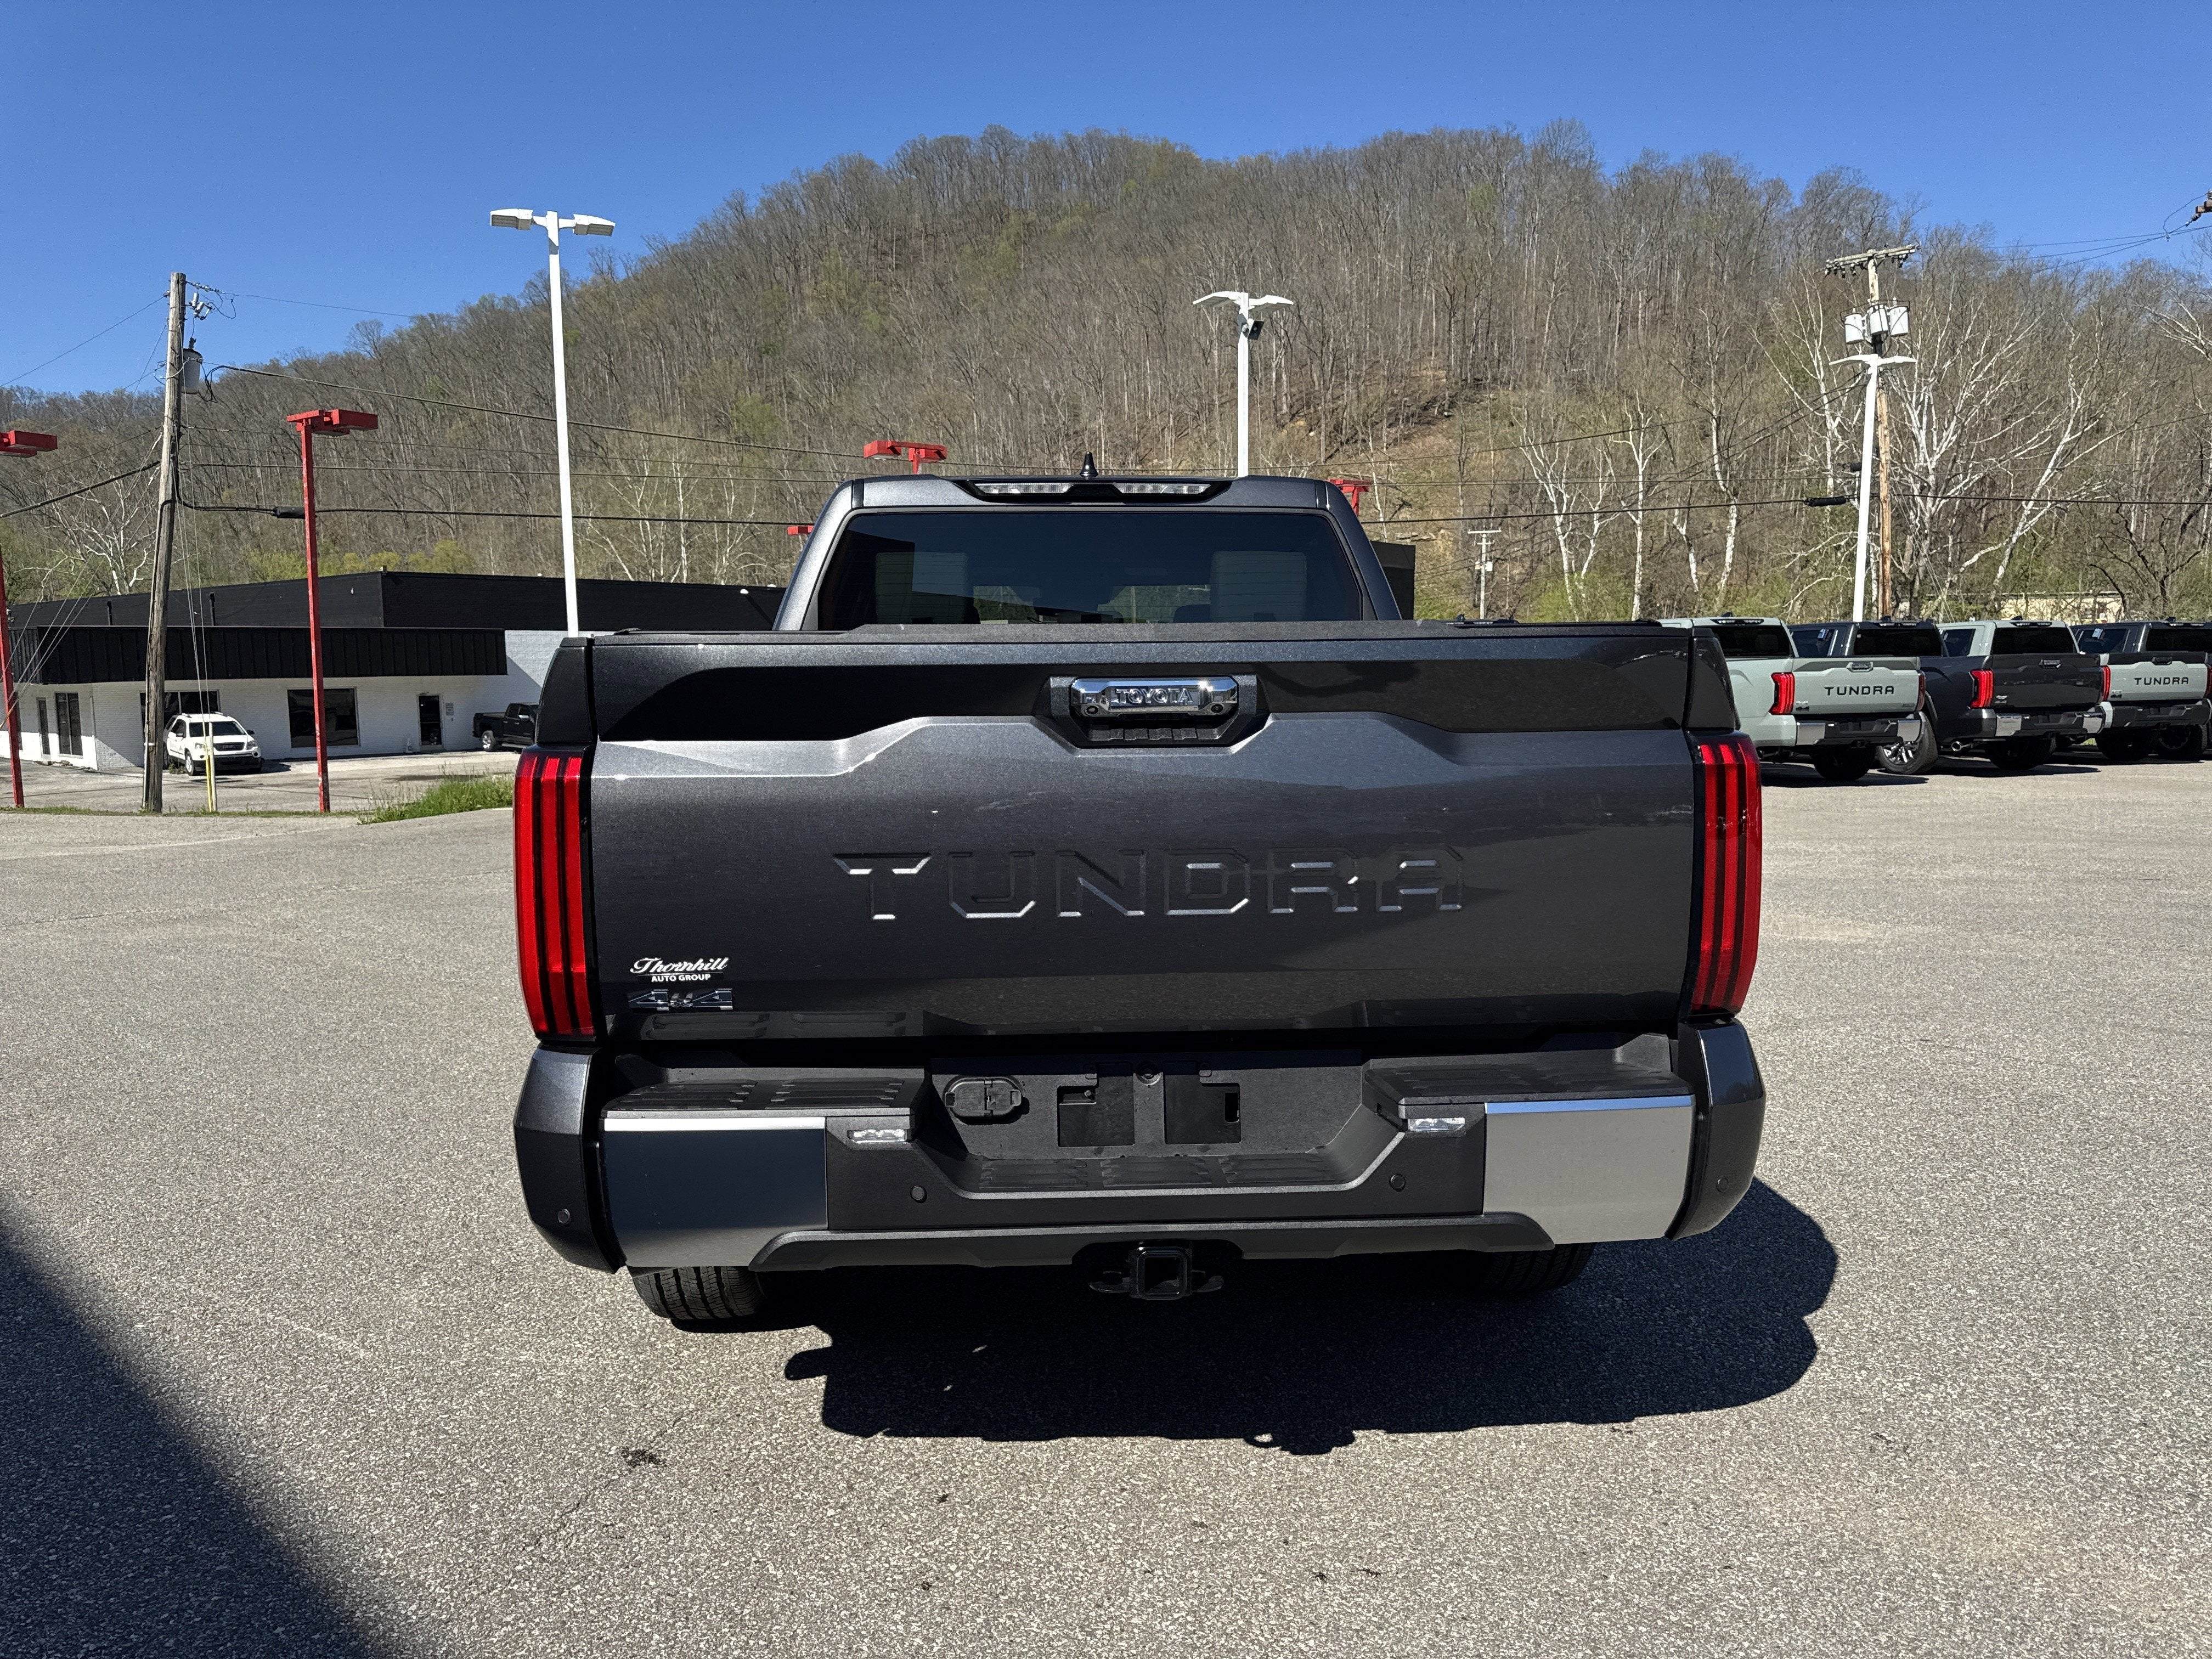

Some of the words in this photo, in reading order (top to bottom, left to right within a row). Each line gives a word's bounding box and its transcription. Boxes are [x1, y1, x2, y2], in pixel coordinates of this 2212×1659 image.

[1116, 688, 1193, 703] TOYOTA
[1825, 686, 1894, 696] TUNDRA
[833, 844, 1463, 919] TUNDRA
[630, 957, 729, 973] Thornhill
